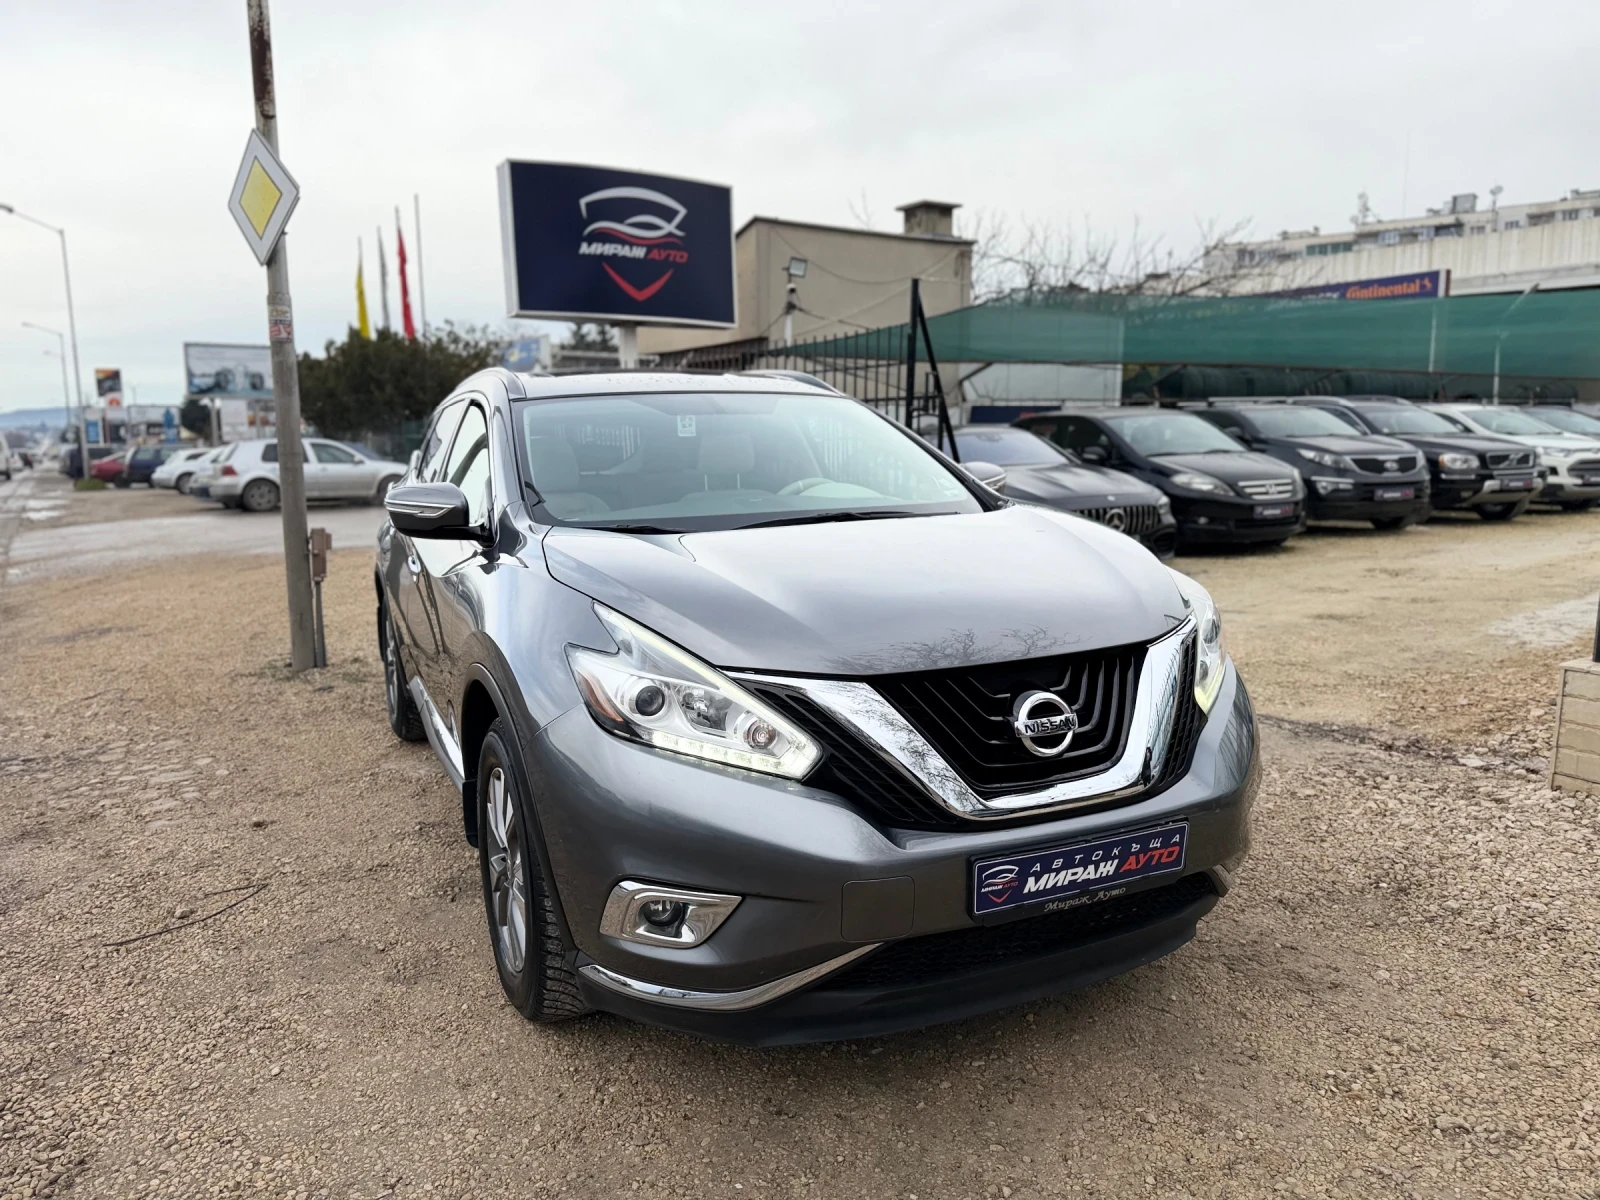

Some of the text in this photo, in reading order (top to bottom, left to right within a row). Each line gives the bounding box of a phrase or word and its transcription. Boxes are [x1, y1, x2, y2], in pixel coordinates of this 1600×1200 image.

[578, 242, 689, 263] МИРАЖ АУТО
[1346, 278, 1420, 300] Continental
[1024, 716, 1075, 734] NISSAN
[1030, 834, 1180, 873] АВТОКЪЩА
[1022, 845, 1180, 894] МИРАЖ АУТО
